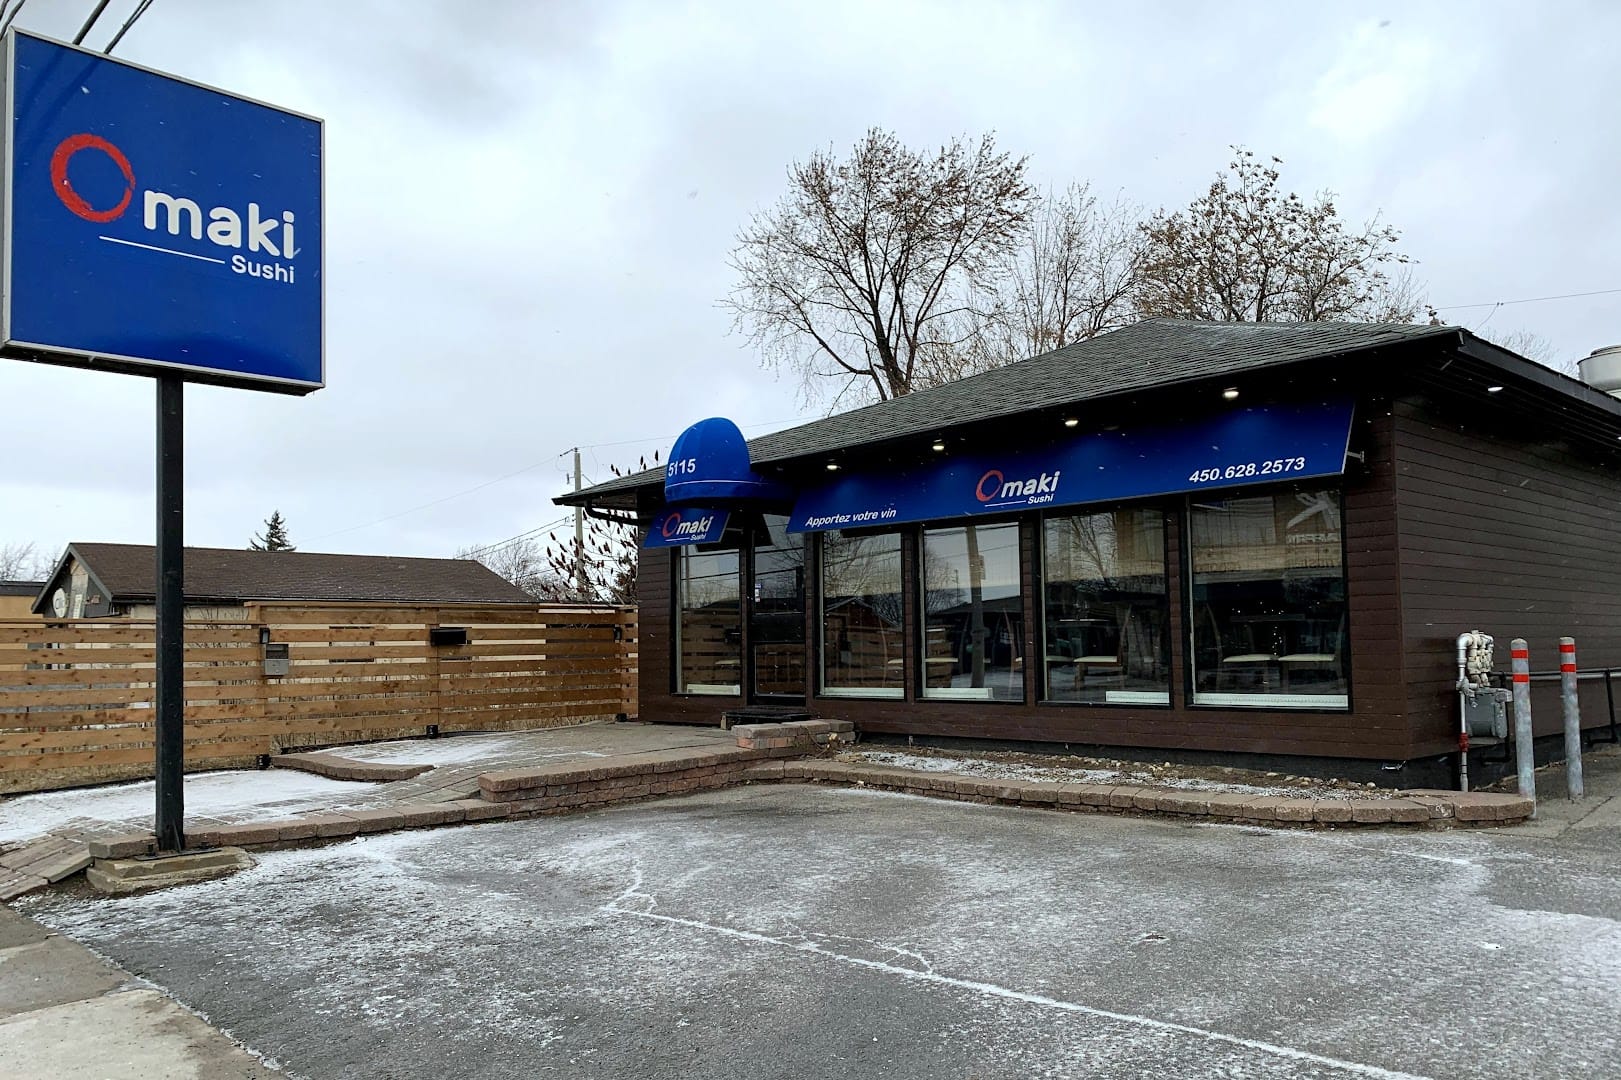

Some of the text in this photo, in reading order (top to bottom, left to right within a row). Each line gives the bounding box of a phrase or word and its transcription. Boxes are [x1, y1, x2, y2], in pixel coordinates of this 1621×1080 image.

[231, 254, 295, 284] Sushi
[667, 458, 696, 477] 5115
[1188, 456, 1306, 483] 450.628.2573
[1027, 493, 1054, 505] Sushi
[804, 508, 897, 528] Apportez votre vin
[690, 533, 706, 542] Sushi
